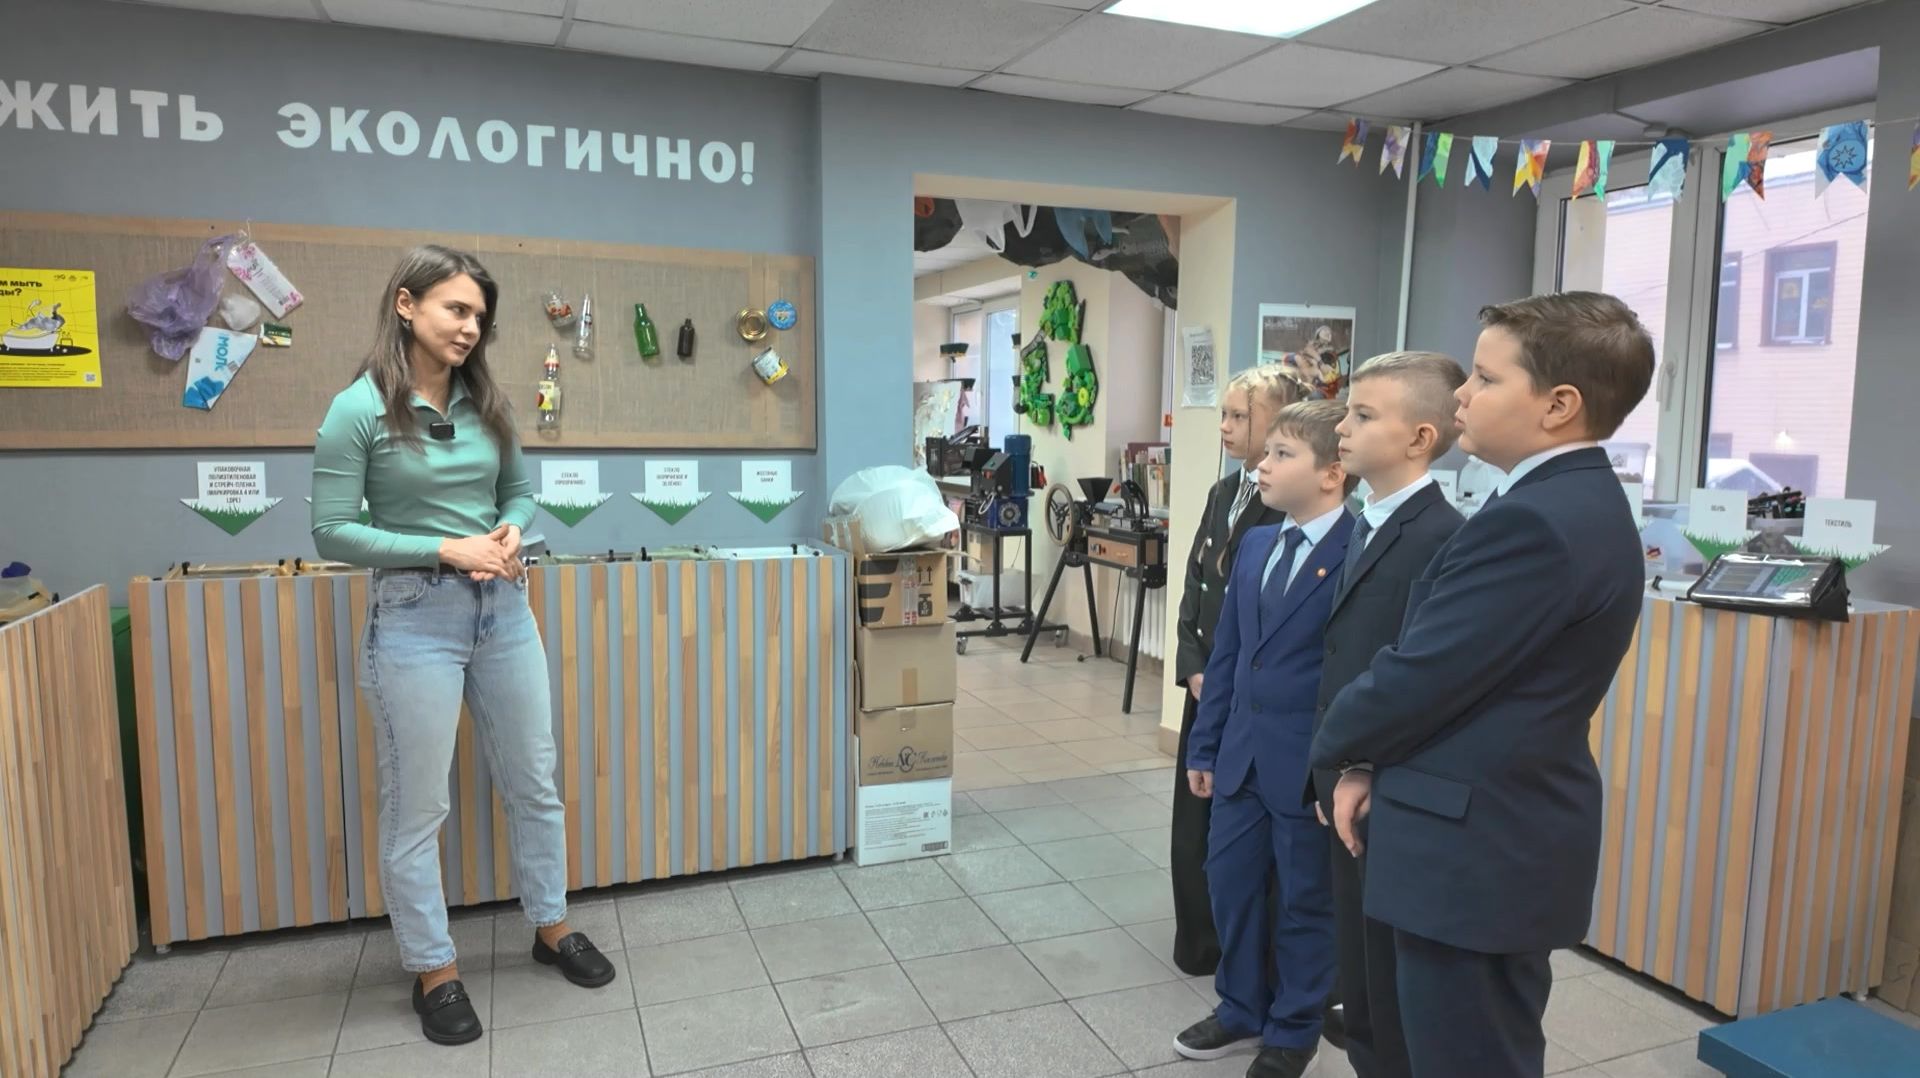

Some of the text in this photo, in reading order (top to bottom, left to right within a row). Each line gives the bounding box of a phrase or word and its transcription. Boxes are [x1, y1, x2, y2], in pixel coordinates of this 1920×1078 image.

[0, 80, 755, 186] ЖИТЬ ЭКОЛОГИЧНО!
[1825, 518, 1853, 528] ТЕКСТИЛЬ
